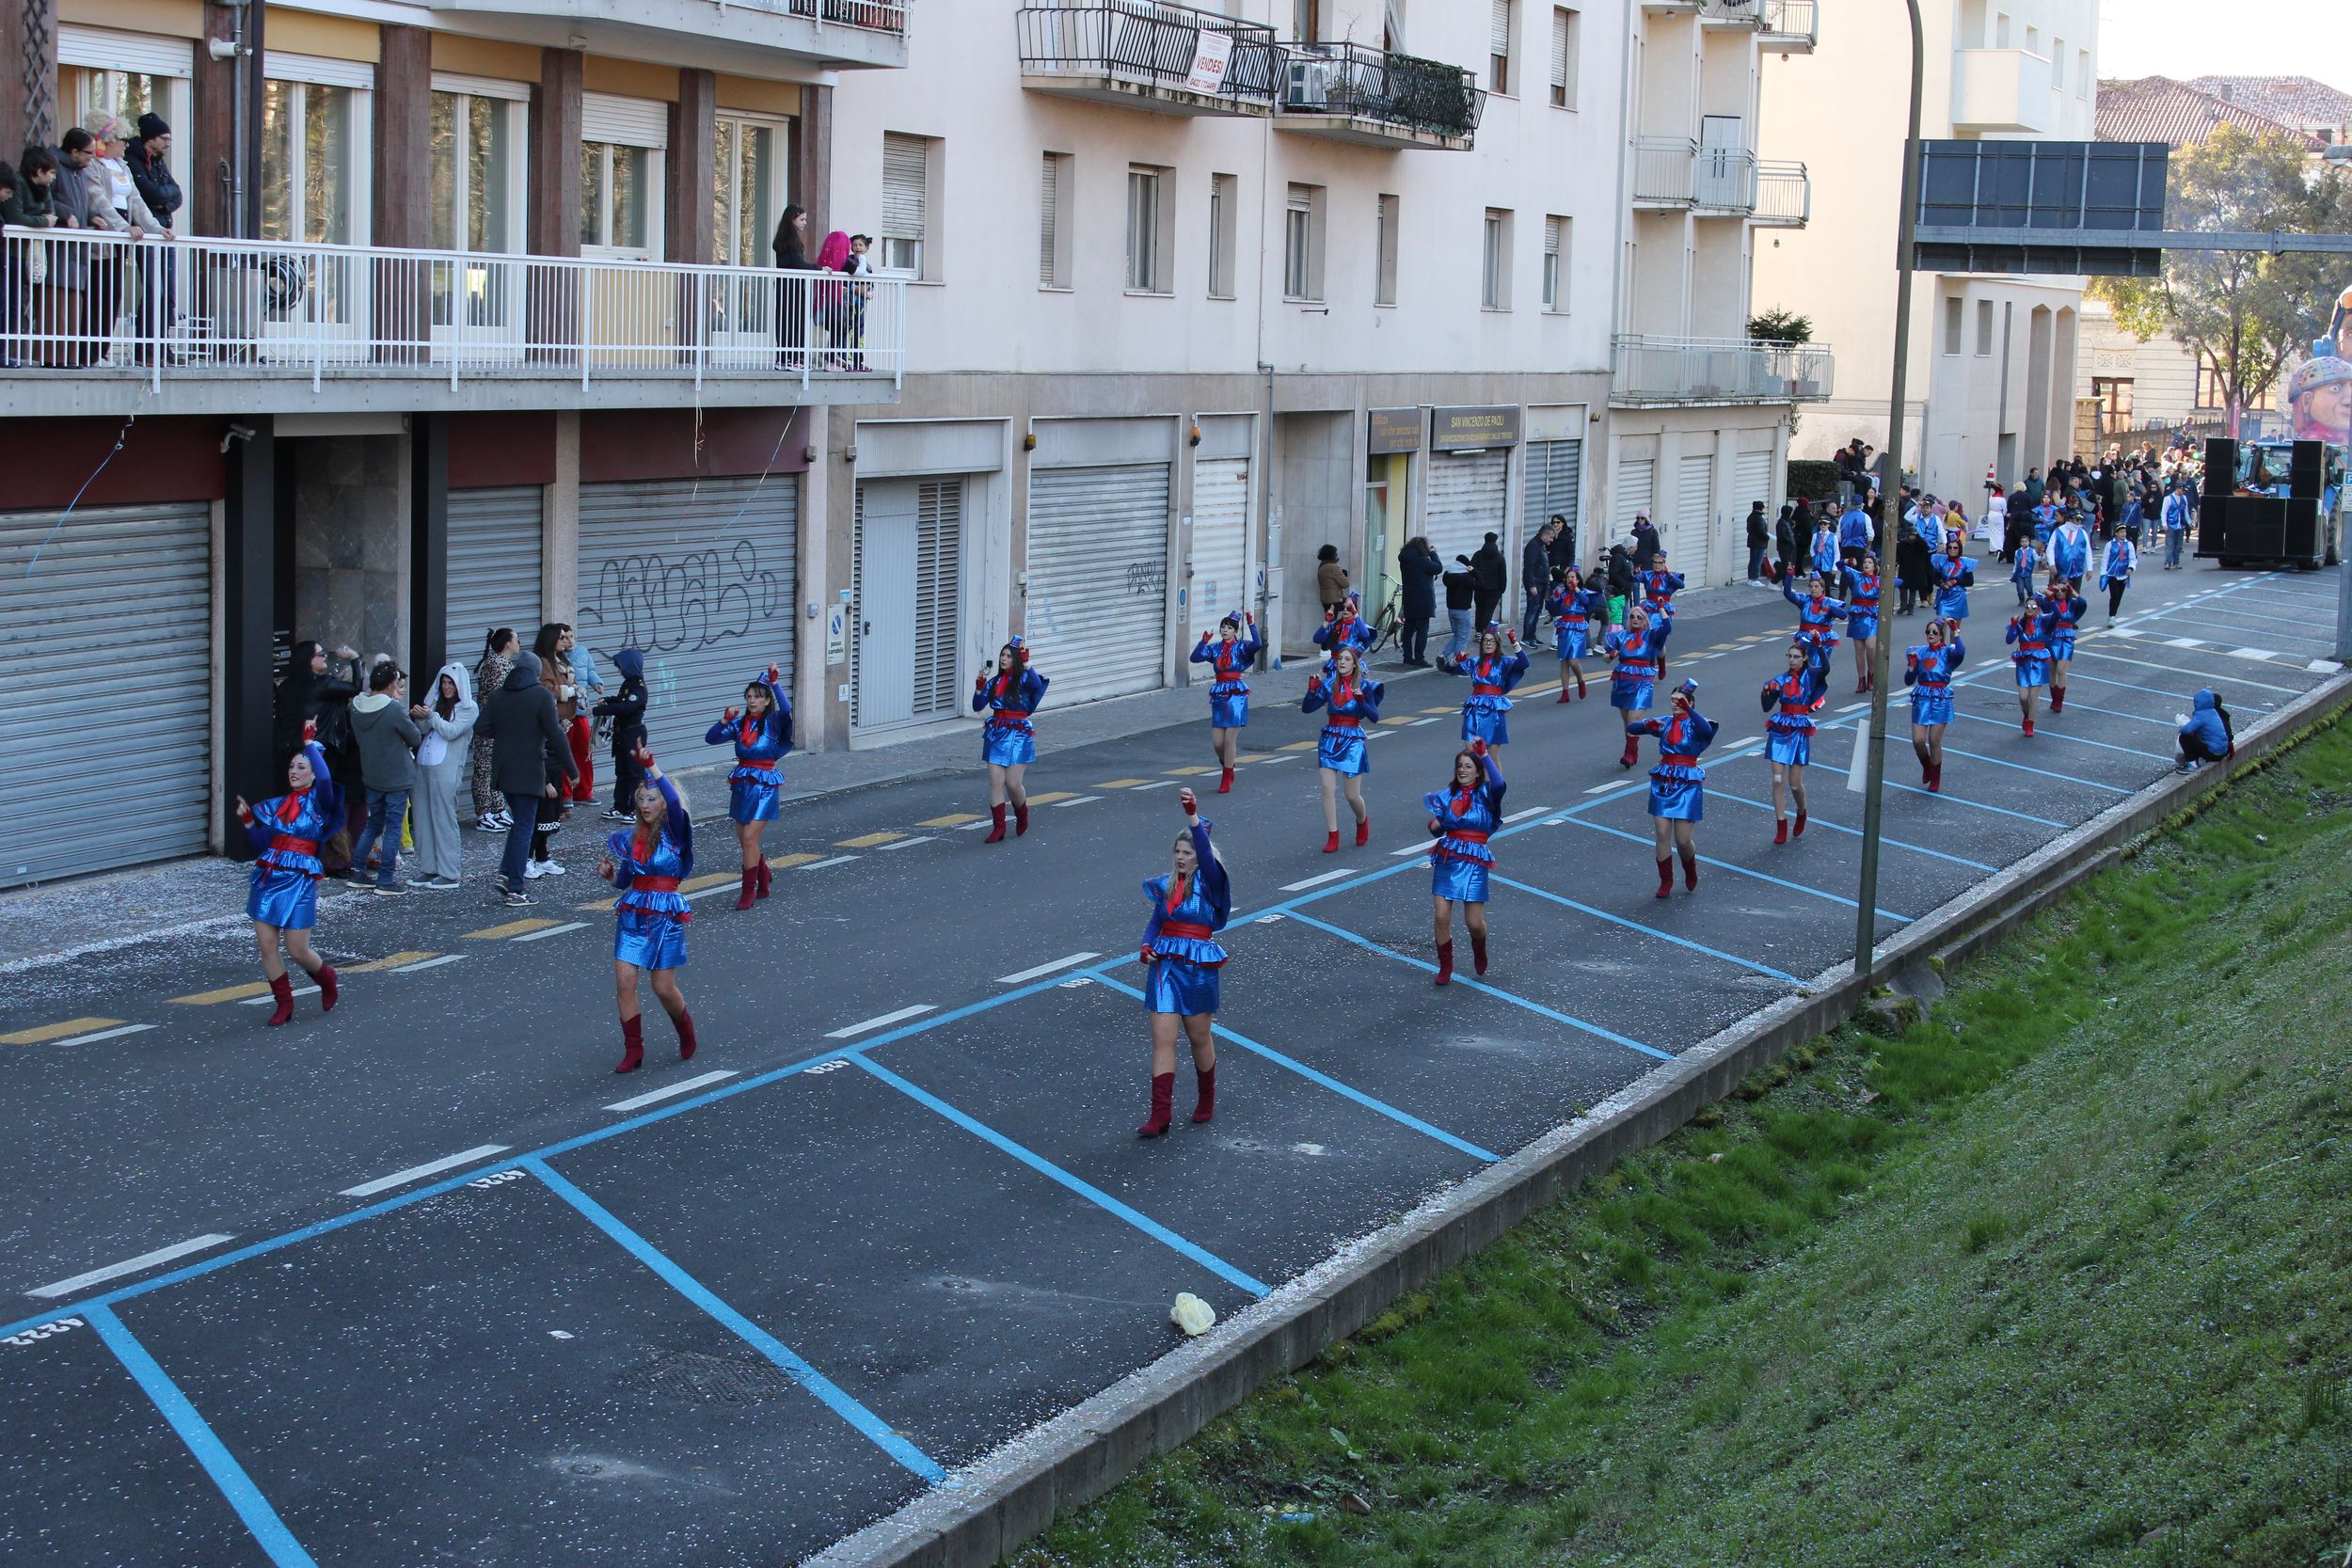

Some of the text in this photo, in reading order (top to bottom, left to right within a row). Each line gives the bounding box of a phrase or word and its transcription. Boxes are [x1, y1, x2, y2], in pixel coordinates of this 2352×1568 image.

[1197, 56, 1224, 74] VENDESI
[1451, 415, 1504, 428] SAN VINCENZO DE PAOLI
[0, 1318, 85, 1345] 4222
